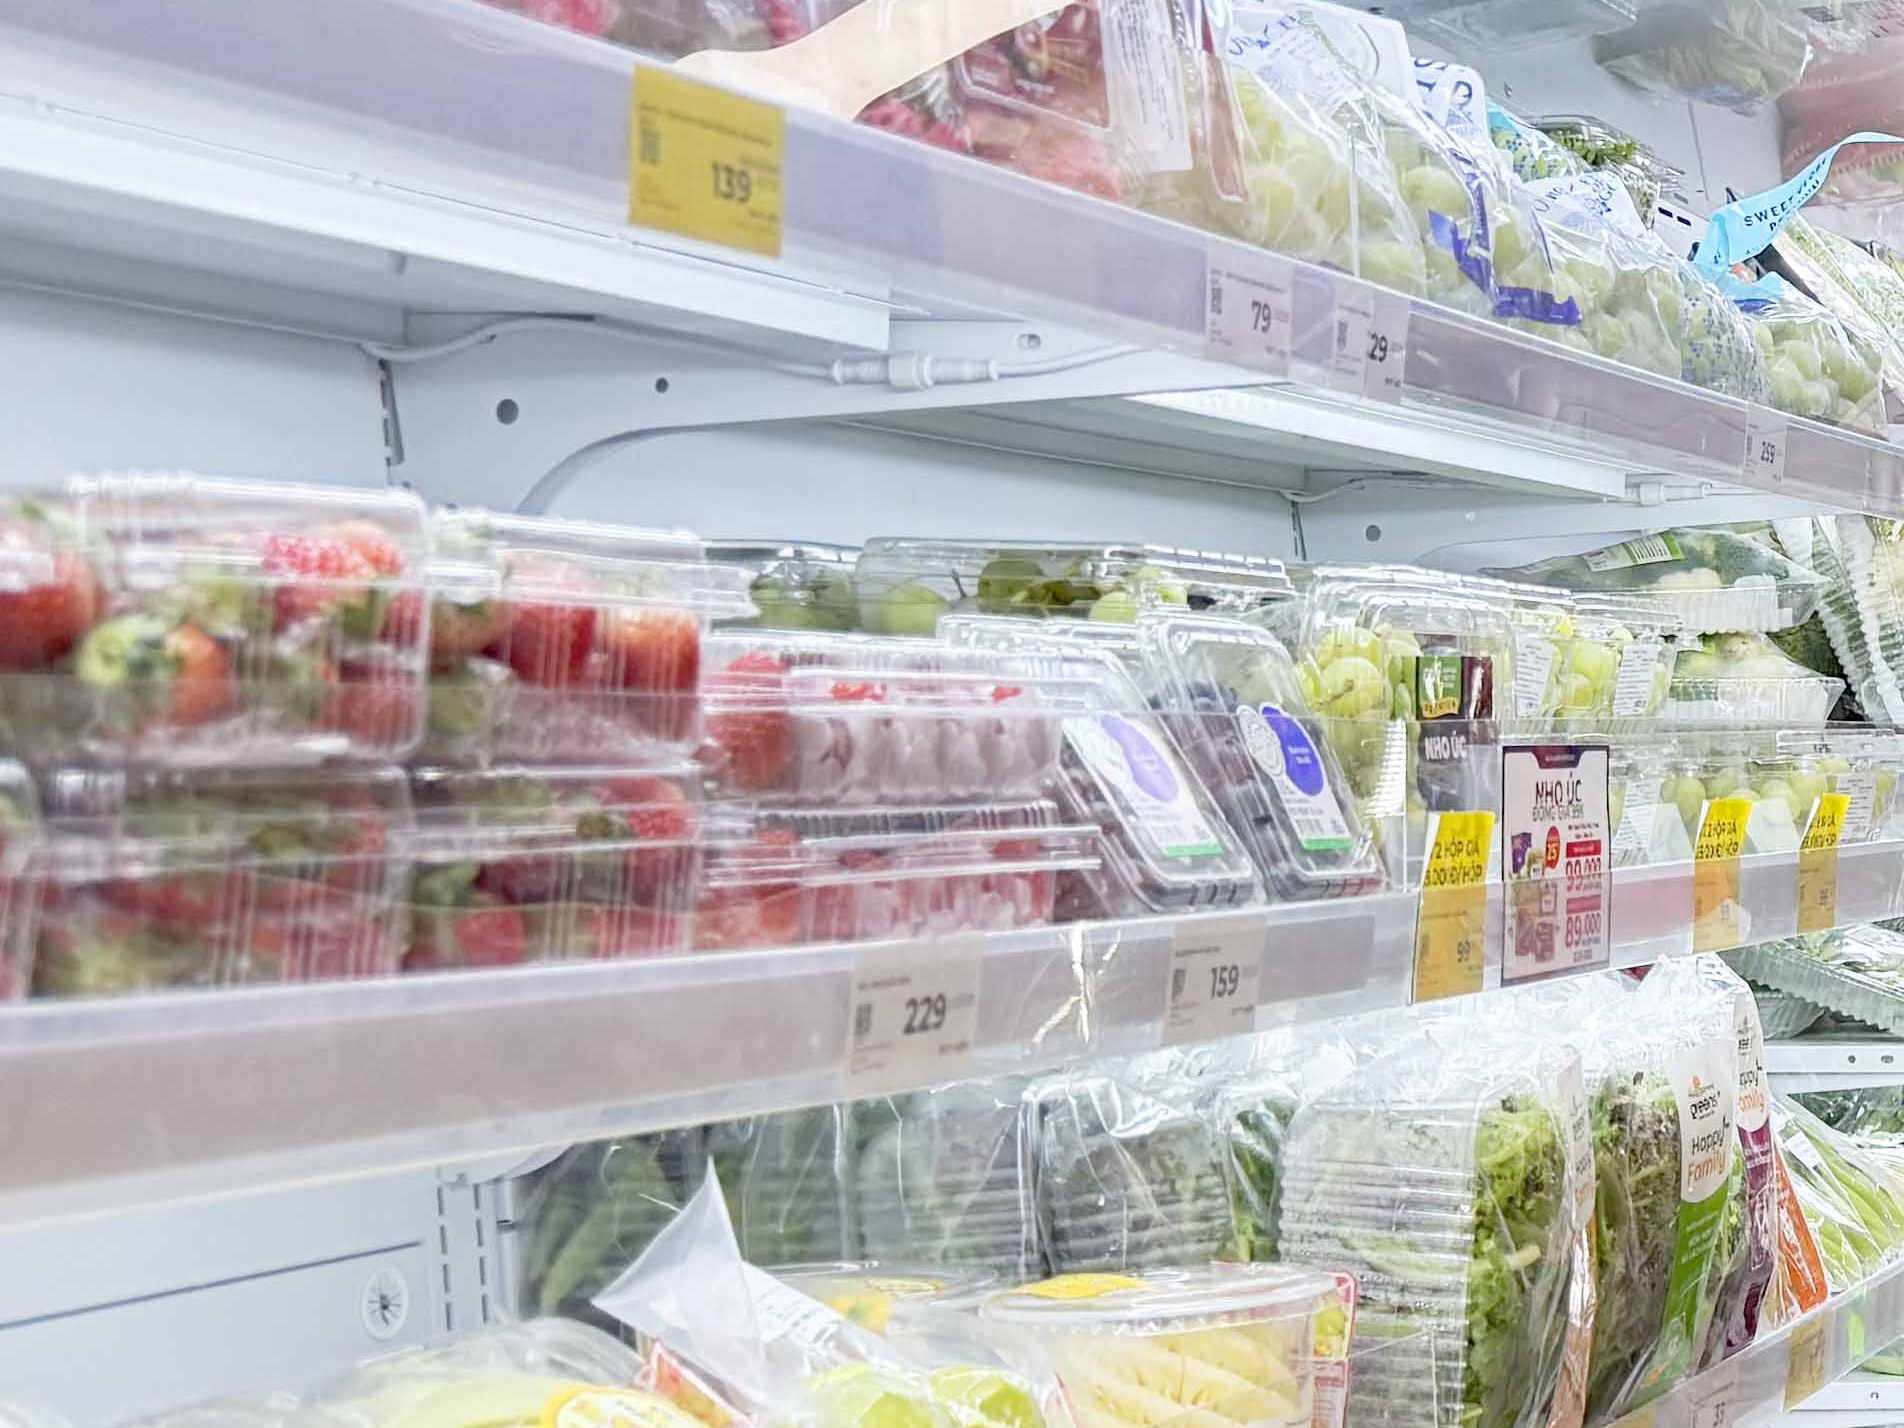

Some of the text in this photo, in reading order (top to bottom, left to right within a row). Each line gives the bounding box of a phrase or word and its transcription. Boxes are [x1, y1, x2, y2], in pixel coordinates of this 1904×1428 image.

[711, 159, 752, 204] 139
[1251, 299, 1272, 333] 79
[1423, 729, 1467, 761] NHO ÚC
[1535, 772, 1583, 804] NHO ÚC
[1210, 965, 1240, 999] 159
[902, 993, 947, 1035] 229
